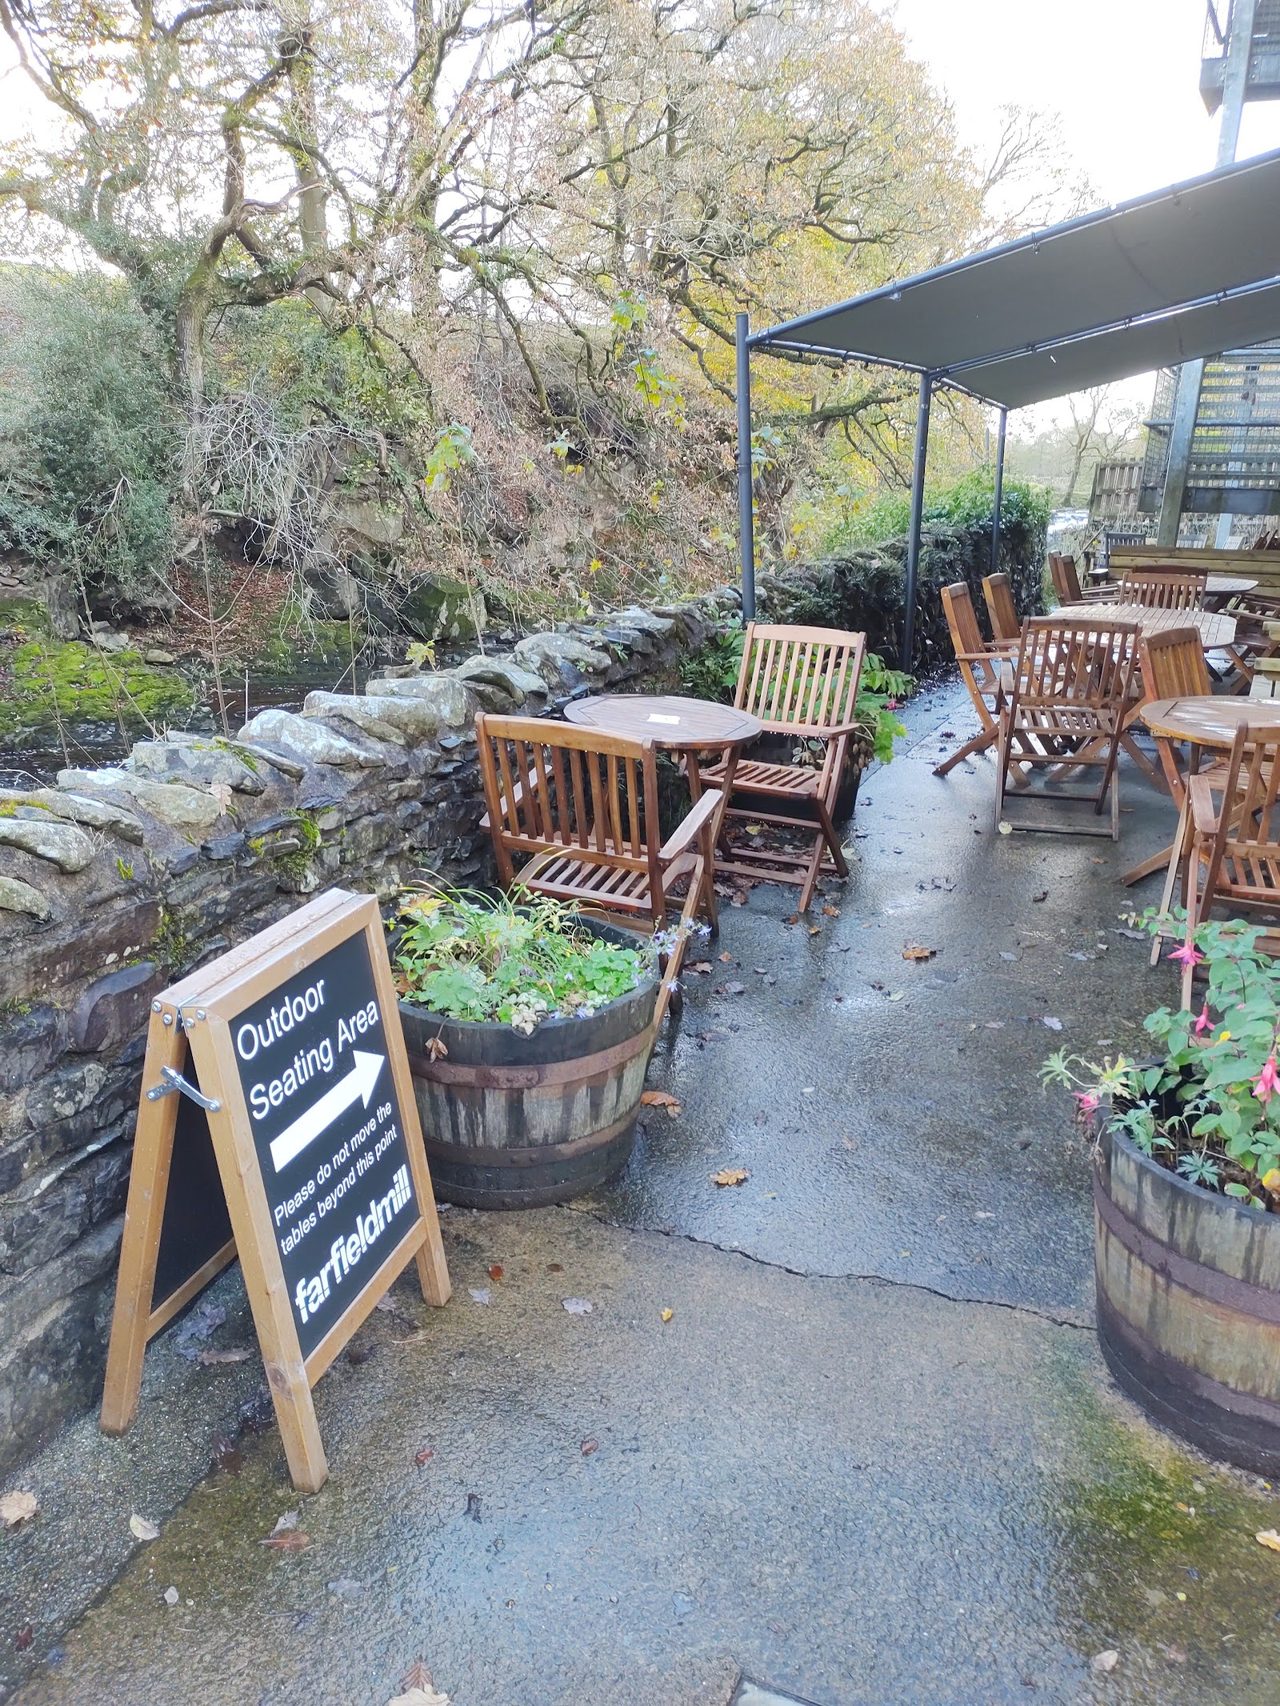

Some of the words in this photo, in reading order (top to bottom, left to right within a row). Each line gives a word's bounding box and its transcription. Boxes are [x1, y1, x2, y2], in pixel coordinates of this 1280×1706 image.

[237, 979, 325, 1060] Outdoor
[250, 1036, 334, 1120] Seating
[338, 1001, 380, 1052] Area
[274, 1179, 315, 1228] Please
[316, 1163, 332, 1184] do
[332, 1142, 350, 1169] not
[350, 1118, 376, 1152] move
[377, 1102, 392, 1124] the
[281, 1212, 317, 1255] tables
[317, 1167, 356, 1218] beyond
[356, 1151, 374, 1177] this
[375, 1124, 397, 1161] point
[295, 1164, 412, 1324] farfieldmill
